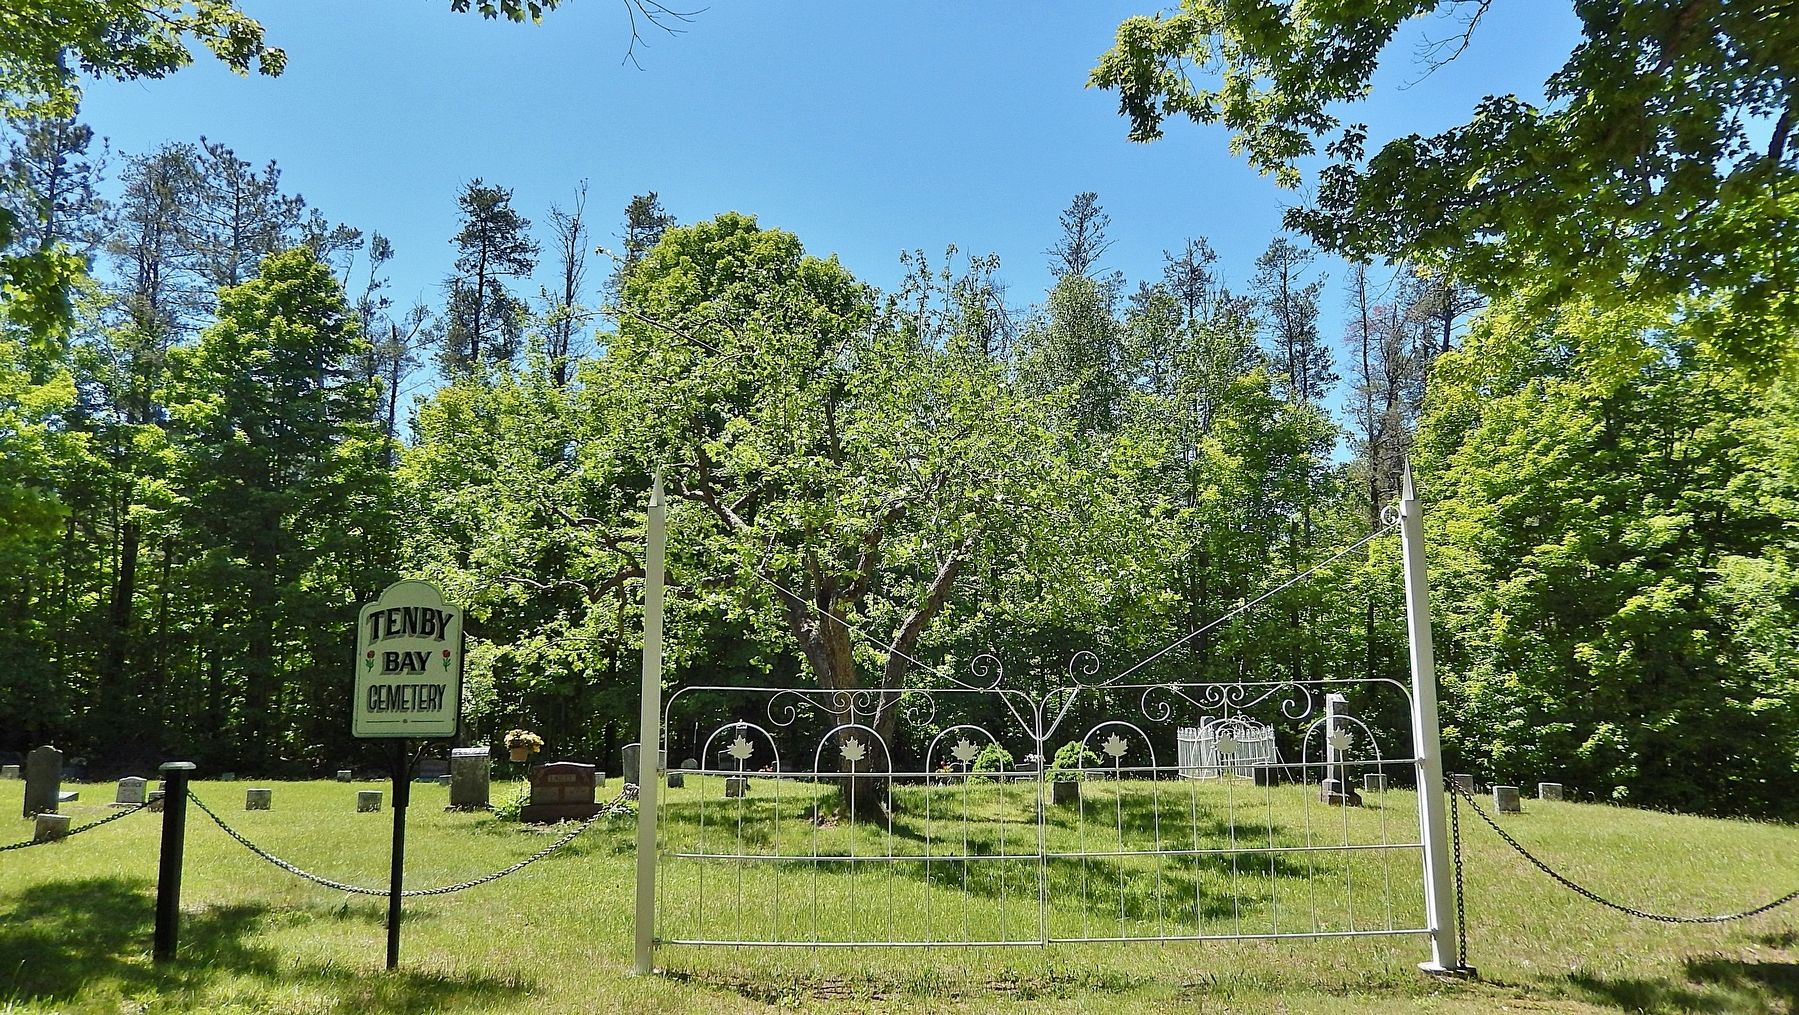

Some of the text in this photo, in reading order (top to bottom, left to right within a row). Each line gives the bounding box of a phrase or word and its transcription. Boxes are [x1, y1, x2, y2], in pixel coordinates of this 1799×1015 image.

[369, 606, 454, 645] TENBY
[382, 651, 432, 674] BAY
[368, 684, 446, 712] CEMETERY
